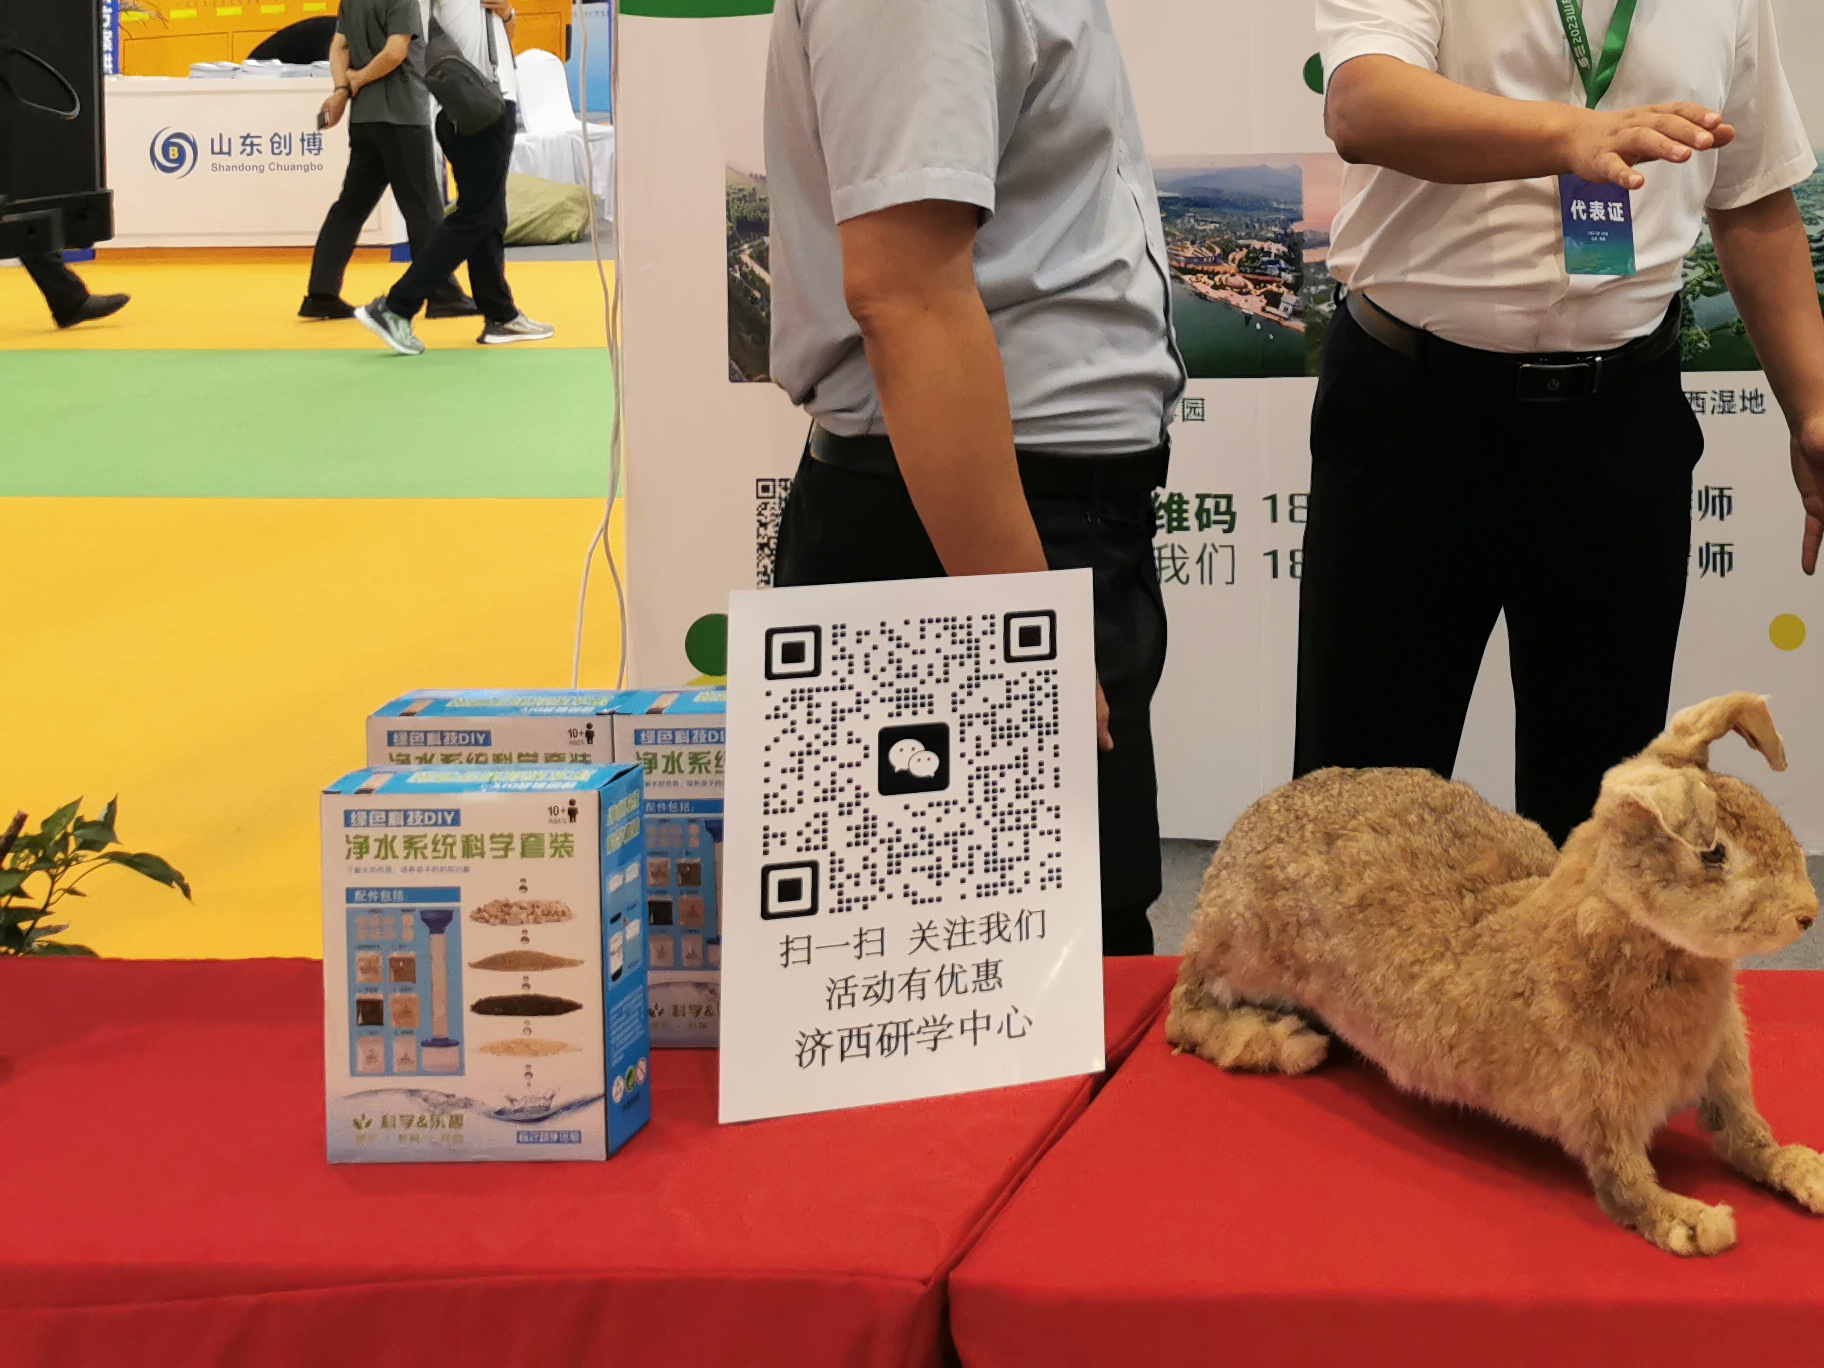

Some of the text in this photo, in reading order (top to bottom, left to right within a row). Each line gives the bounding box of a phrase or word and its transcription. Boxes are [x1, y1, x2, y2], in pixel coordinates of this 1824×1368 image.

[210, 131, 324, 157] 山东创博
[211, 162, 324, 173] Shandong Chuangbo
[1570, 199, 1625, 222] 代表证
[1685, 388, 1767, 415] 西湿地
[1154, 492, 1238, 534] 维码
[1697, 485, 1734, 522] 师
[1155, 542, 1236, 586] 我们
[1698, 541, 1735, 580] 师
[345, 832, 576, 861] 净水系统科学套装
[779, 908, 1047, 968] 扫一扫 关注我们
[824, 958, 1005, 1011] 活动有优惠
[794, 1005, 1033, 1069] 济西研学中心
